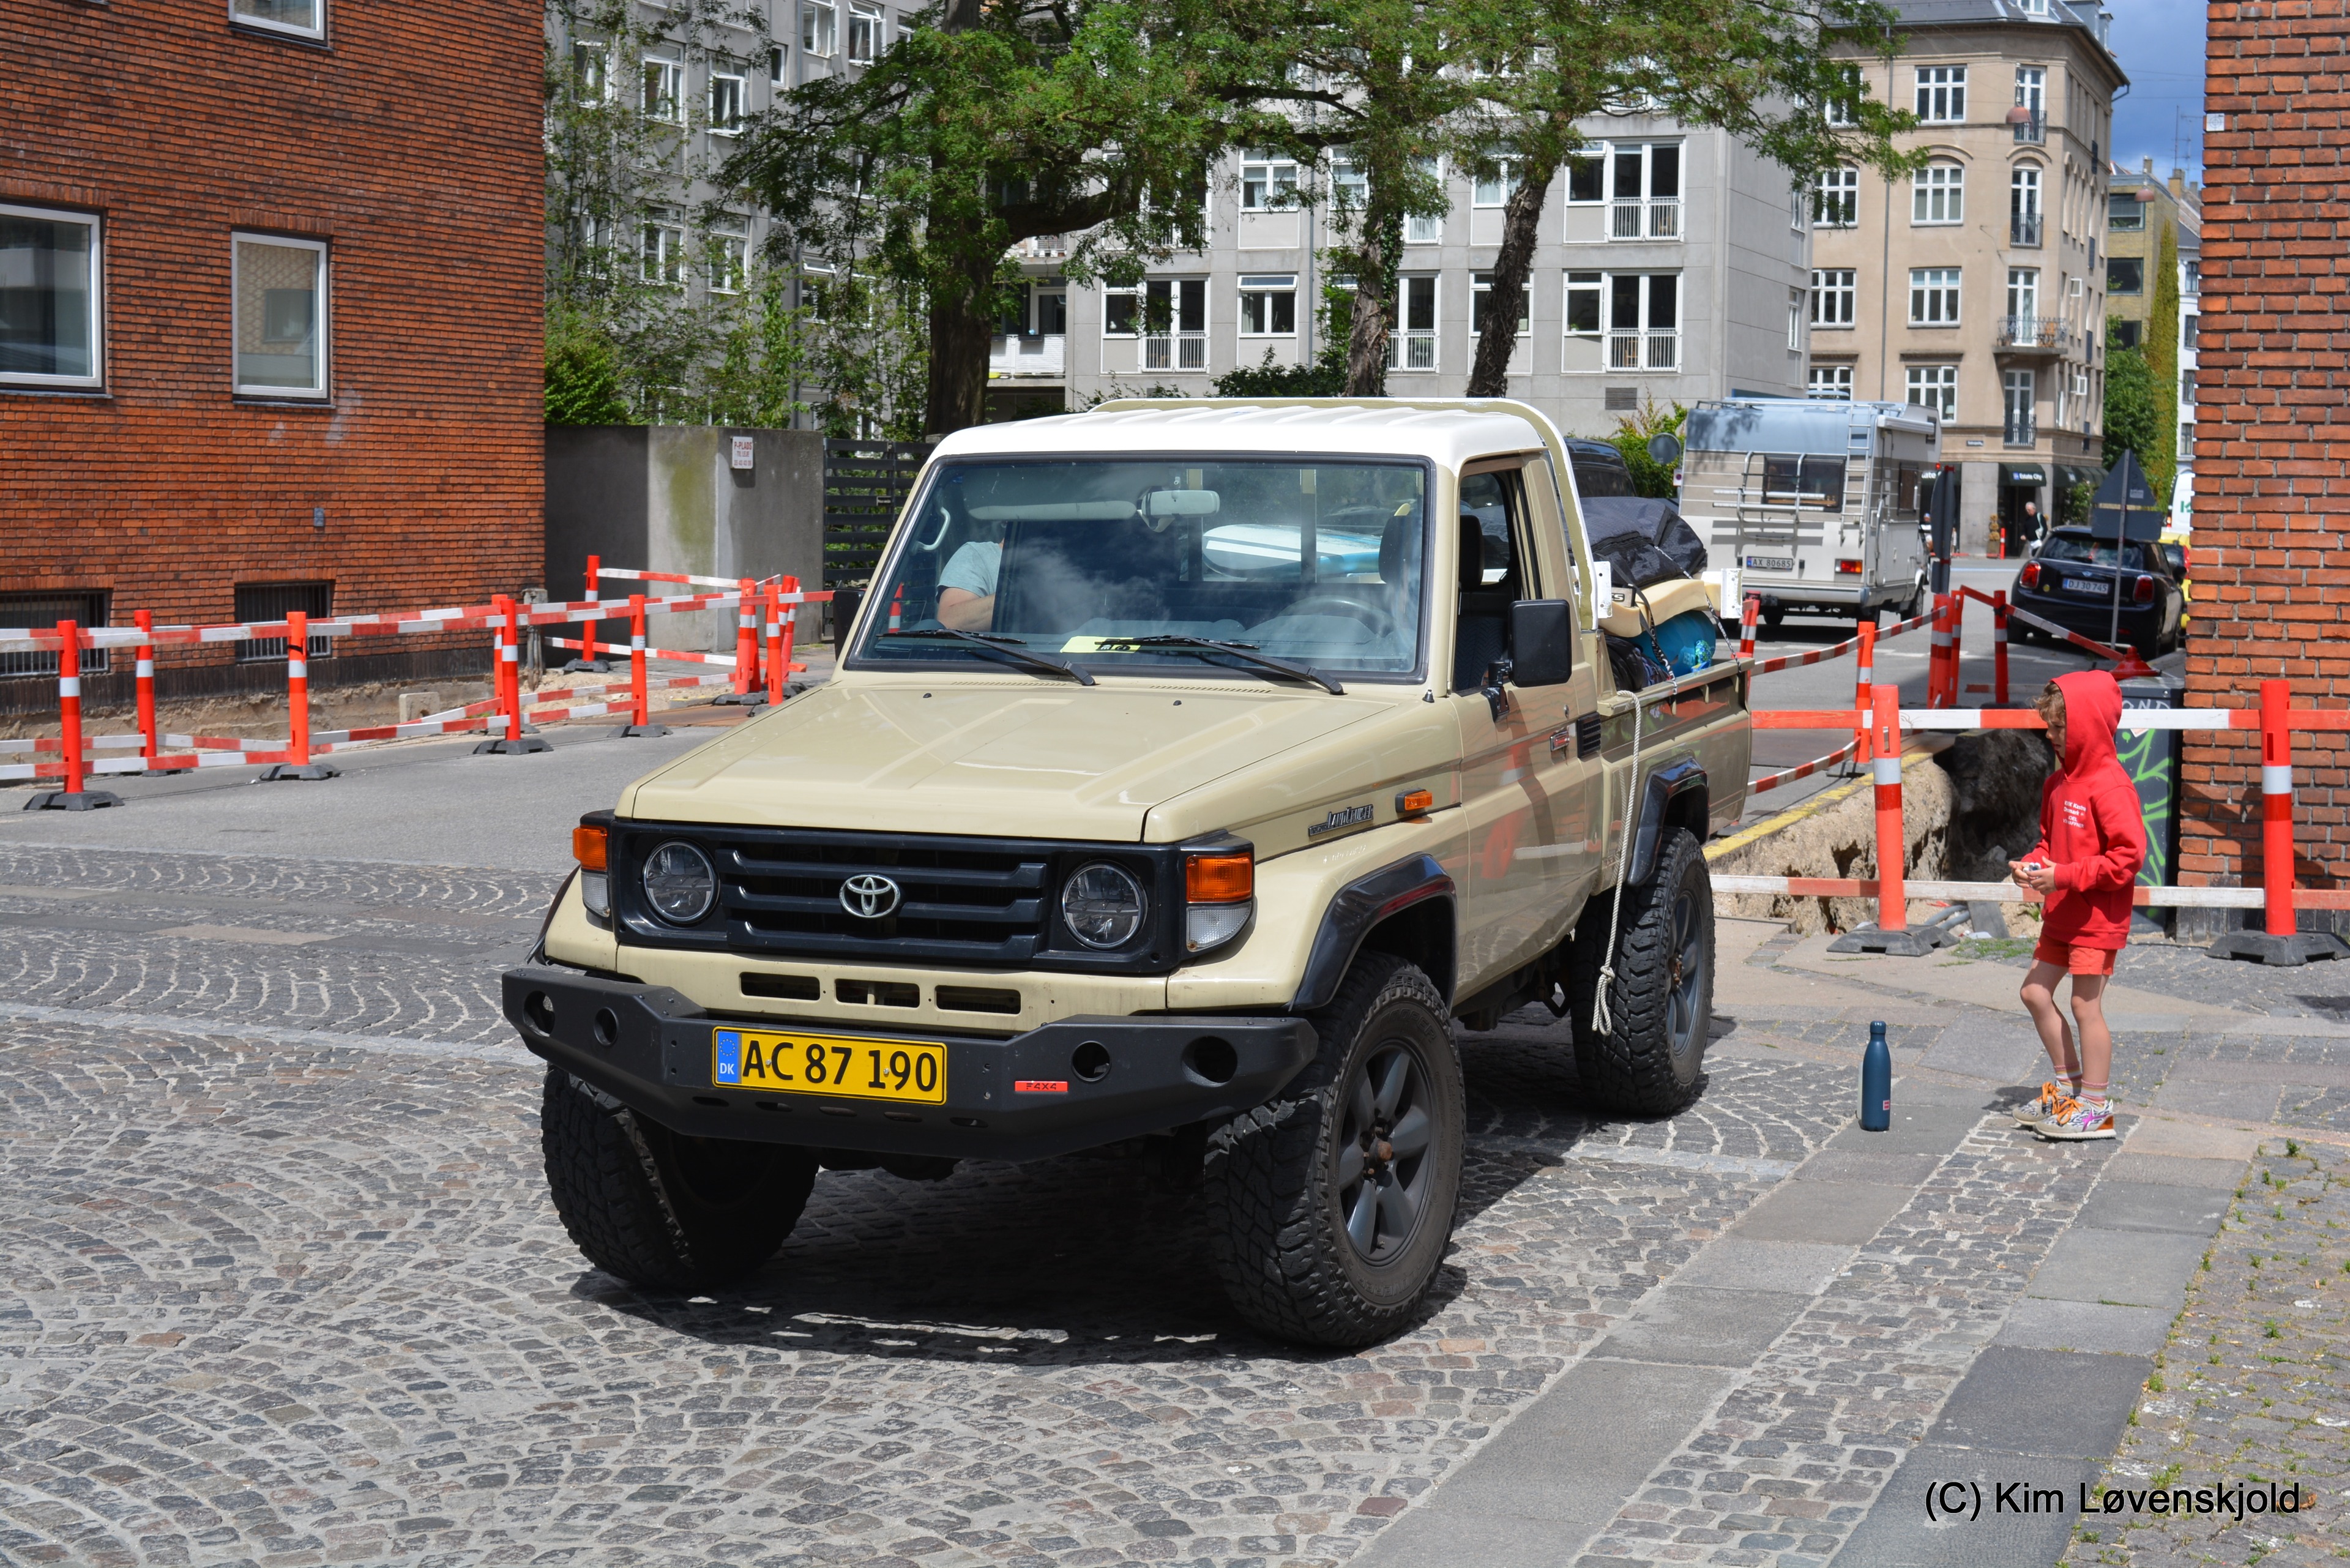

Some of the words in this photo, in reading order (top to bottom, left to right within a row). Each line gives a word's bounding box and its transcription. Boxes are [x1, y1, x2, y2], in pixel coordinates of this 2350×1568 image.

[2068, 580, 2079, 589] DJ
[2093, 583, 2107, 592] 745
[720, 1063, 734, 1075] DK
[742, 1040, 793, 1080] AC
[805, 1043, 852, 1085] 87
[868, 1050, 937, 1092] 190
